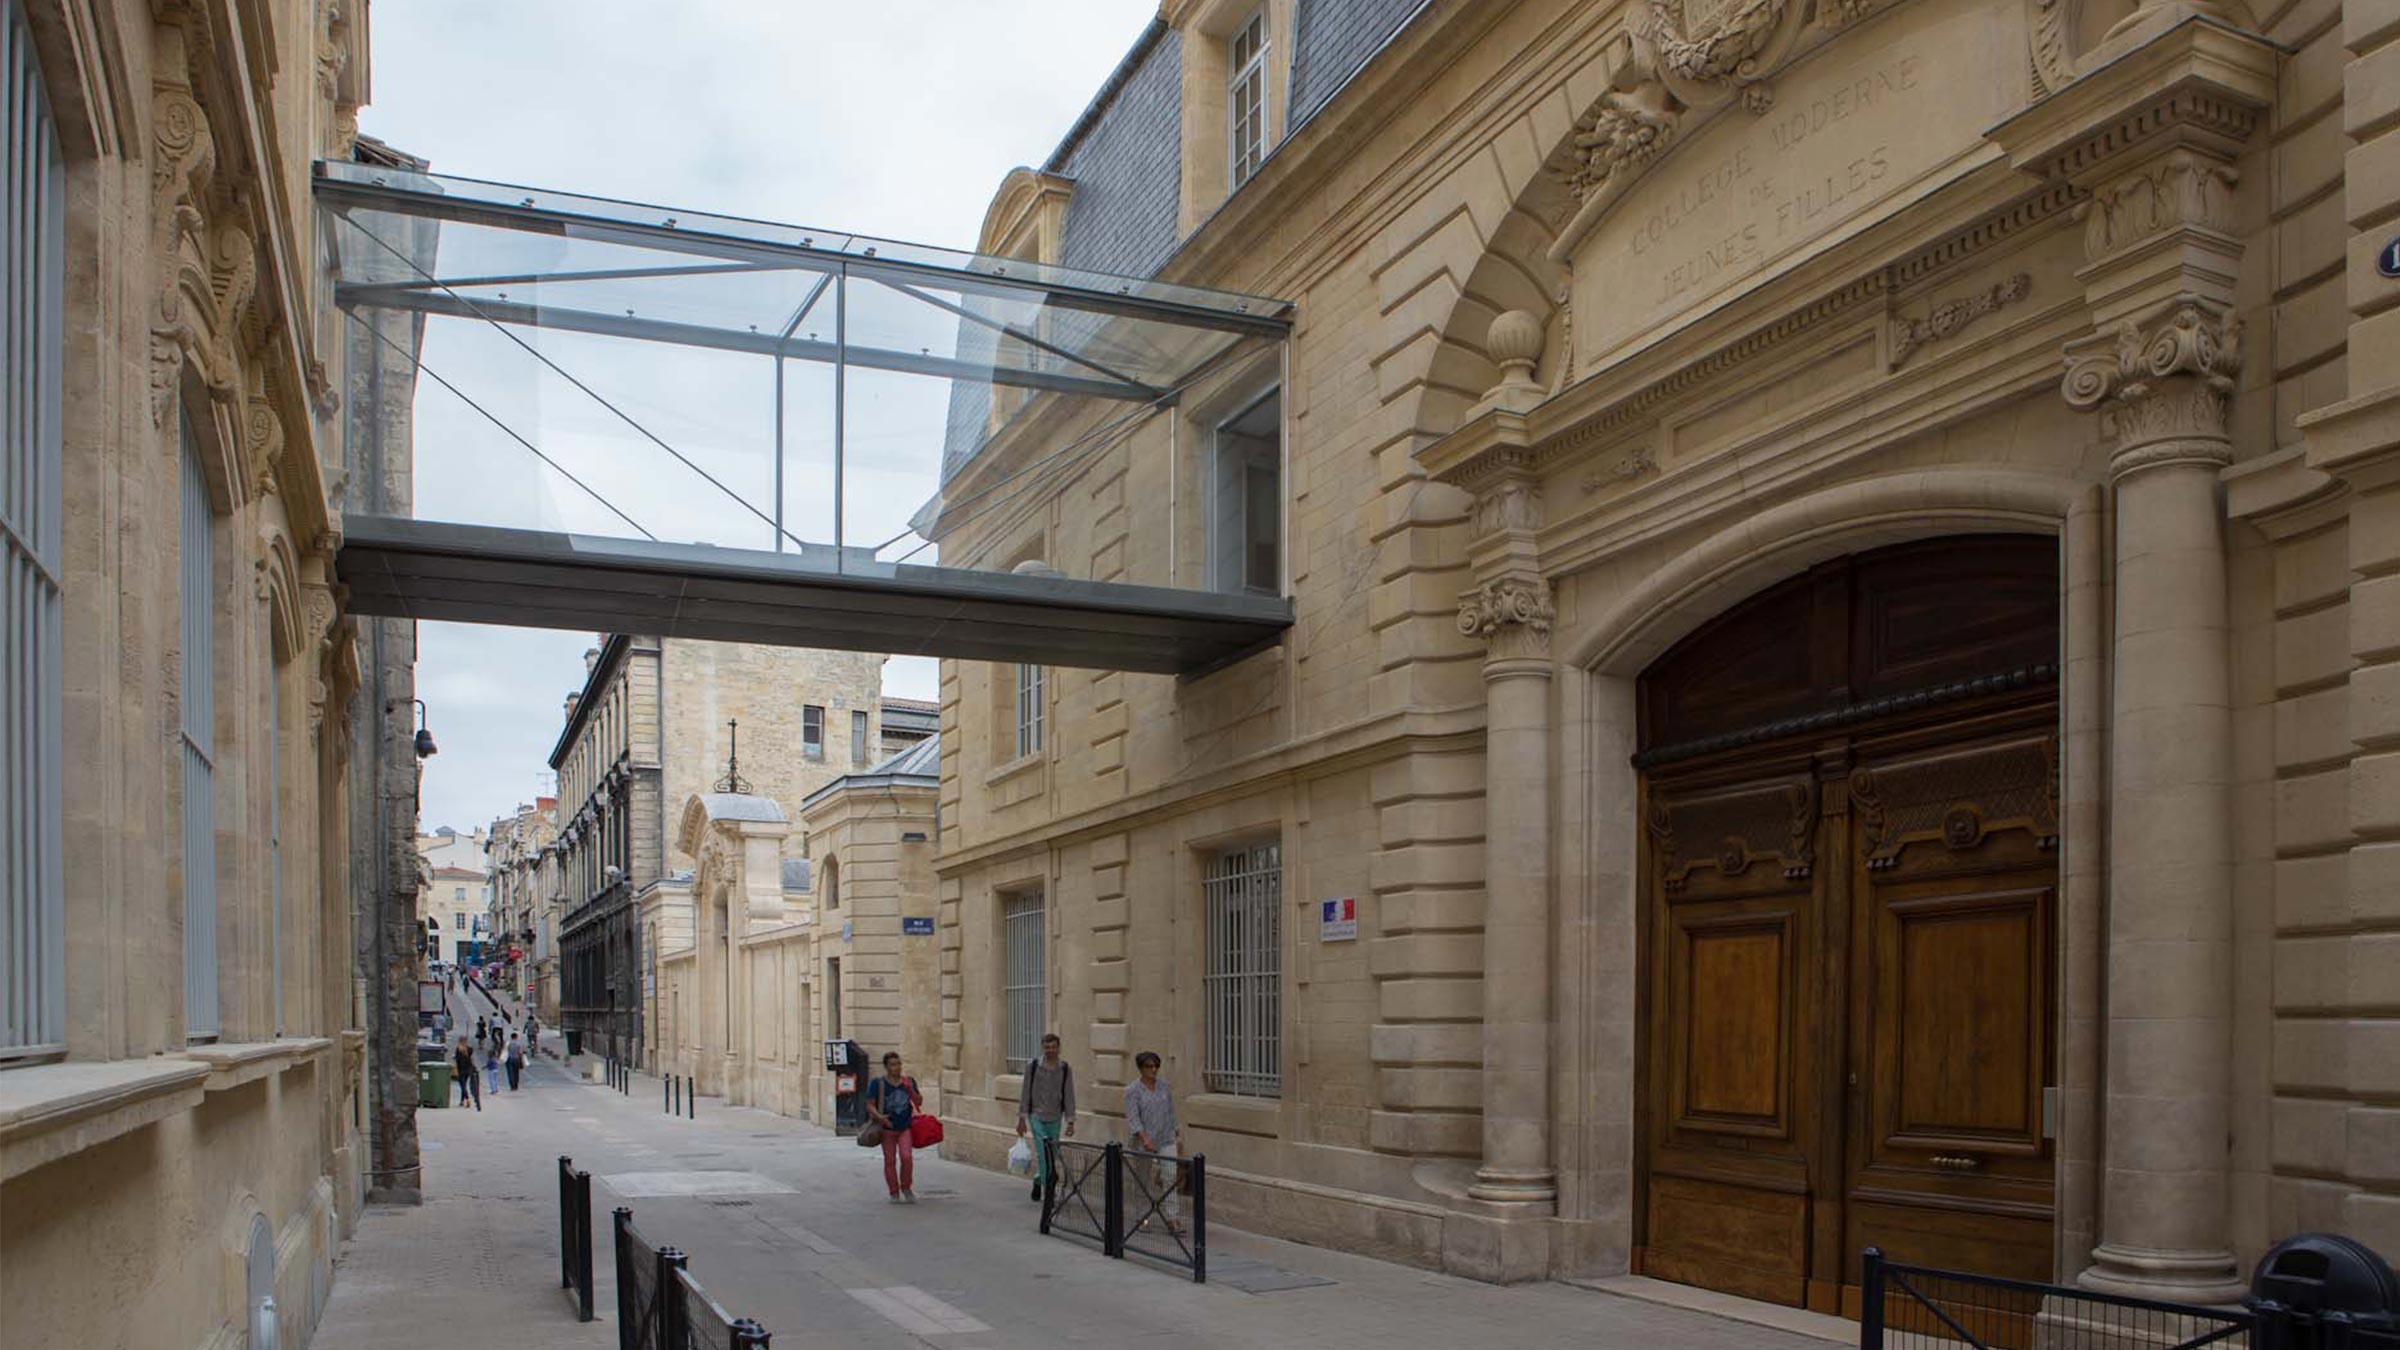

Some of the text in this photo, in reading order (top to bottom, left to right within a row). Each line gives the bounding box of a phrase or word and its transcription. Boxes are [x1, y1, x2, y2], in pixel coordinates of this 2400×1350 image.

[1631, 55, 1919, 256] COLLEGE MODERNE
[1656, 145, 1888, 305] JEUNES FILLES
[1750, 176, 1776, 207] DE
